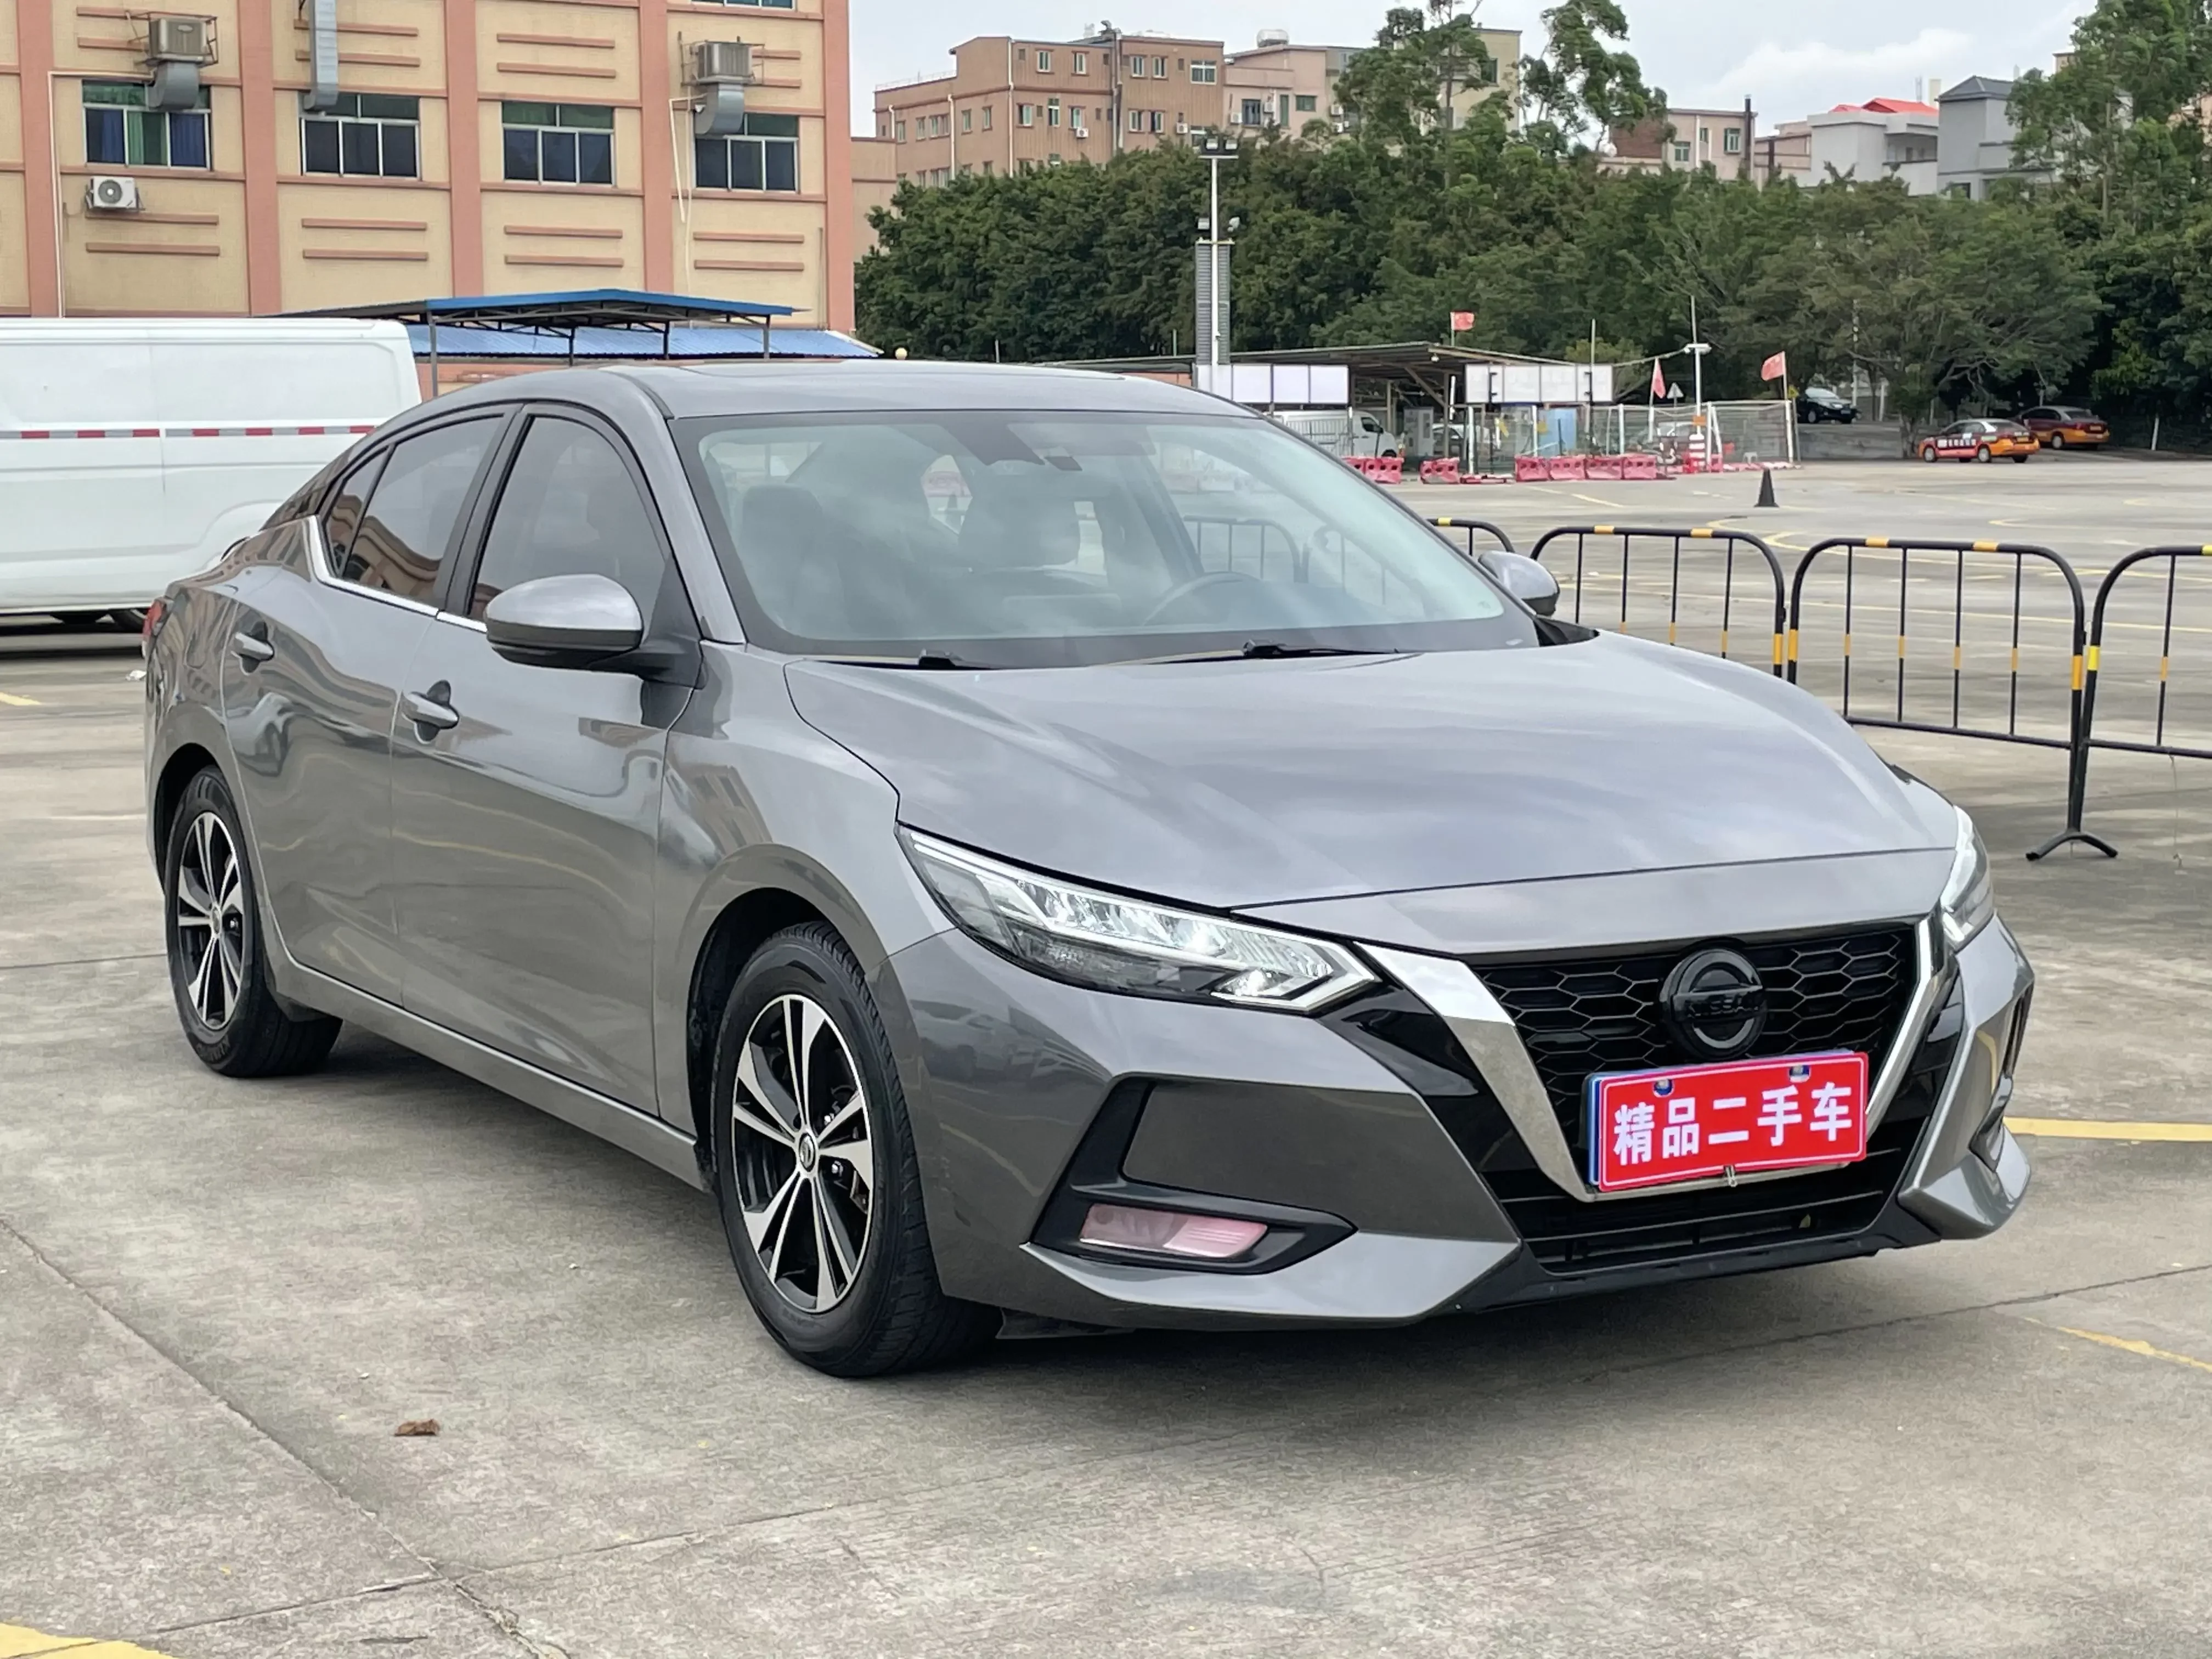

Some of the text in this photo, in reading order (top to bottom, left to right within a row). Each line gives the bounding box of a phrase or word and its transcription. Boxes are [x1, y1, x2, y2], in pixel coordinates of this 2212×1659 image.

[1686, 994, 1759, 1018] NSSA
[1613, 1082, 1852, 1166] 精品二手车
